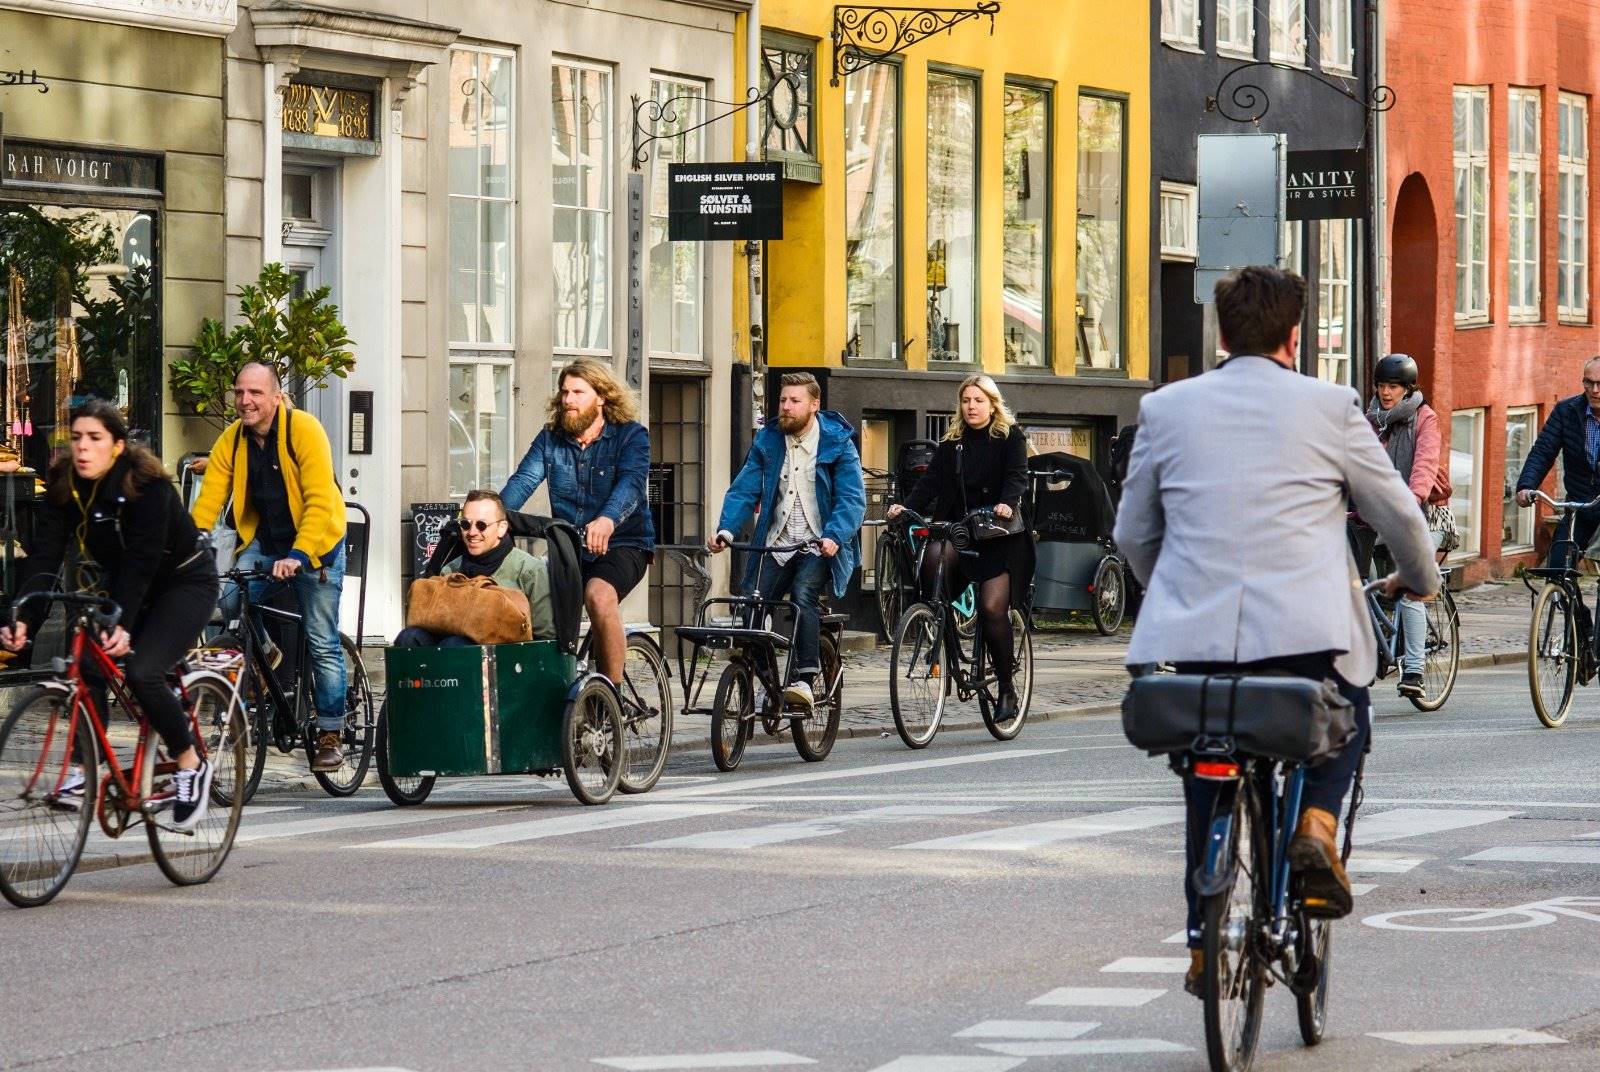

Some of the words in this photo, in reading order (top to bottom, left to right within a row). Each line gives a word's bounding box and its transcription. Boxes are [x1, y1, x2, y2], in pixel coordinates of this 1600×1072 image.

[8, 153, 43, 174] RAH
[56, 158, 112, 180] VOIGT
[674, 174, 711, 183] ENGLISH
[714, 174, 743, 182] SILVER
[746, 173, 776, 182] HOUSE
[1286, 190, 1301, 199] IR
[1308, 190, 1315, 199] &
[1322, 189, 1356, 198] STYLE
[700, 194, 740, 205] SØLVET
[741, 194, 751, 204] &
[700, 204, 752, 214] KUNSTEN
